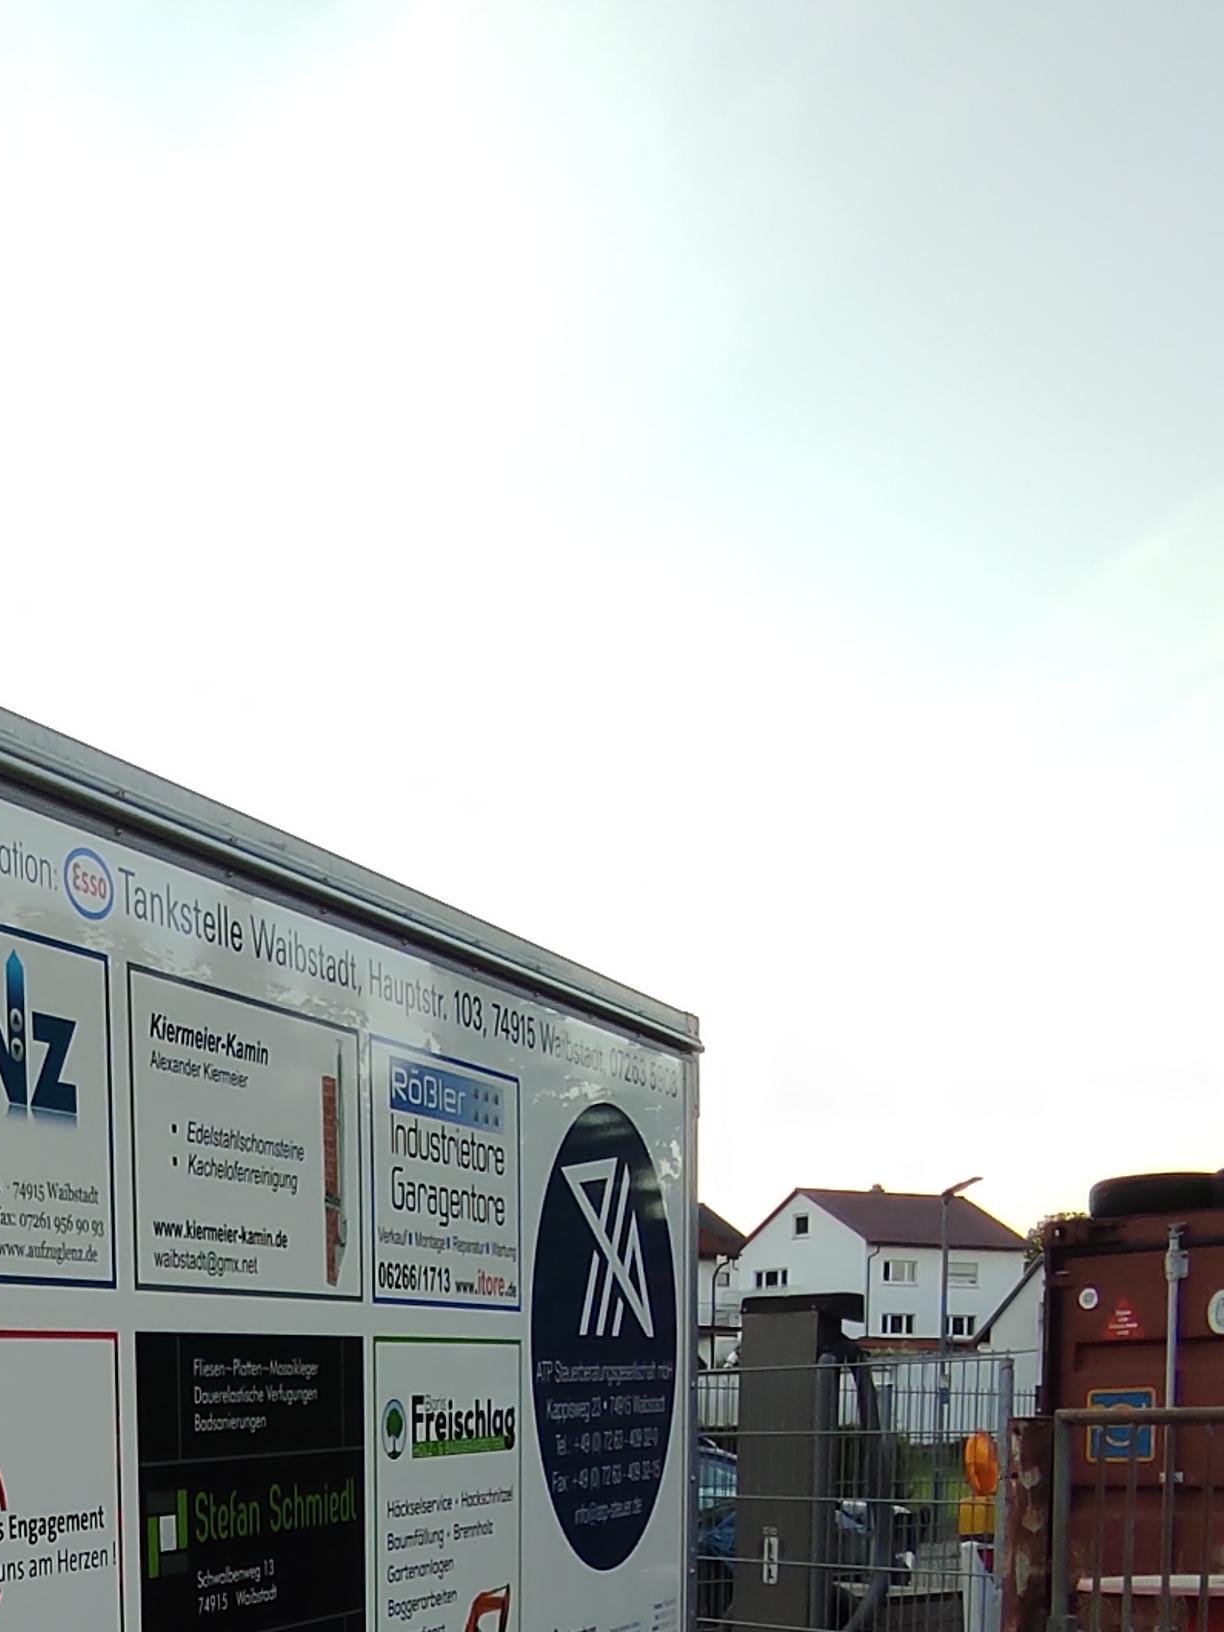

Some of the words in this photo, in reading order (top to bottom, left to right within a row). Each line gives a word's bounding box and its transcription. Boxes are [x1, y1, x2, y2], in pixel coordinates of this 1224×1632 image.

[117, 867, 244, 953] Tankstelle
[249, 915, 363, 996] Waibstadt,
[368, 958, 447, 1019] Hauptstr.
[453, 989, 487, 1038] 103,
[491, 1003, 536, 1050] 74915
[150, 1013, 269, 1066] Kiermeier-Kamin
[150, 1050, 201, 1079] Alexander
[203, 1062, 248, 1089] Kiermeier
[187, 1121, 305, 1162] Edelstahlschornsteine
[390, 1113, 506, 1176] Industrietore
[188, 1153, 298, 1195] Kachelofenreinigung
[13, 1181, 45, 1203] 74915
[47, 1182, 99, 1205] Waibstadt
[390, 1166, 506, 1227] Garagentore
[19, 1213, 51, 1233] 07261
[53, 1213, 74, 1232] 956
[153, 1219, 289, 1249] www.kiermeier-kamin.de
[154, 1249, 259, 1276] waibstadt@gmx.net
[378, 1261, 451, 1294] 06266/1713
[194, 1384, 264, 1405] Dauerelastische
[265, 1383, 318, 1406] Verfugungen
[194, 1412, 267, 1433] Badsanierungen
[411, 1395, 516, 1450] Freischlag
[8, 1505, 105, 1544] Engagement
[195, 1489, 261, 1543] Stefan
[269, 1477, 357, 1533] Schmiedl
[453, 1518, 494, 1541] Brennholz
[28, 1556, 54, 1579] am
[57, 1547, 110, 1576] Herzen
[196, 1564, 261, 1590] Schwalbenweg
[264, 1558, 275, 1578] 13
[387, 1555, 455, 1584] Gartenanlagen
[198, 1592, 229, 1616] 74915
[236, 1583, 278, 1607] Waibstadt
[387, 1587, 458, 1622] Baggerarbeiten
